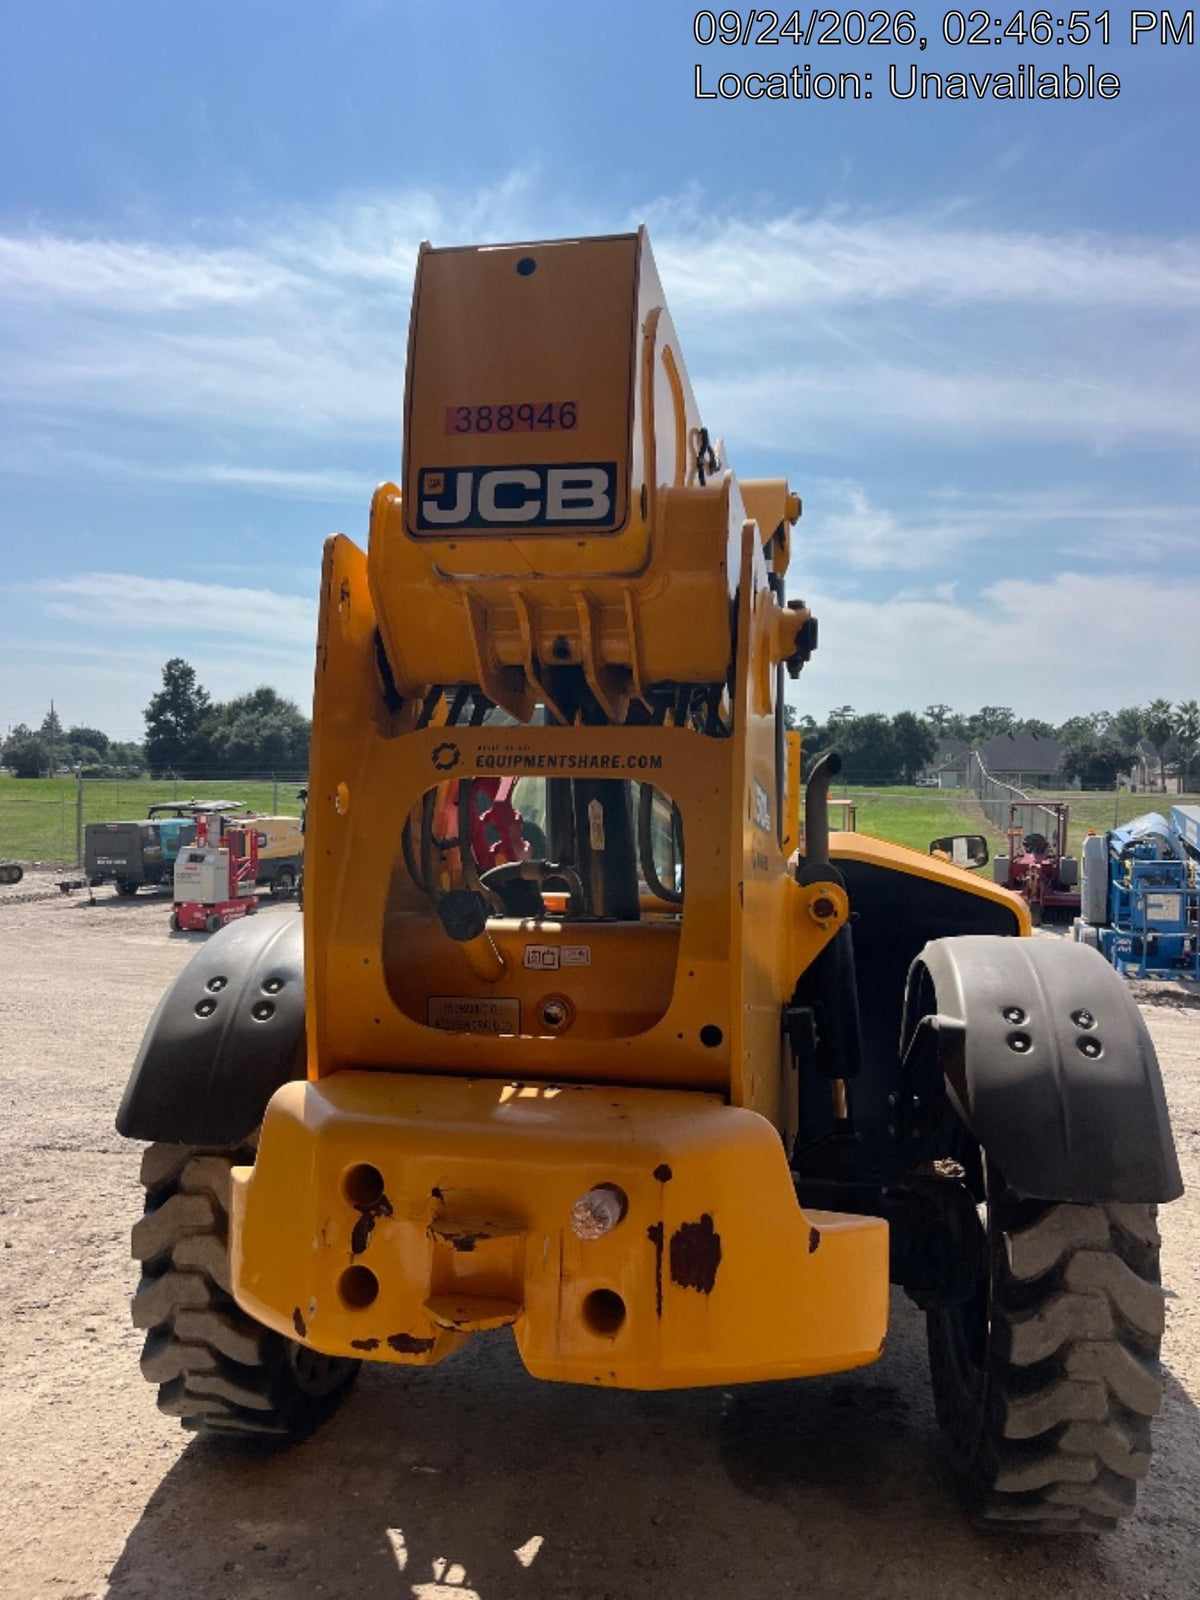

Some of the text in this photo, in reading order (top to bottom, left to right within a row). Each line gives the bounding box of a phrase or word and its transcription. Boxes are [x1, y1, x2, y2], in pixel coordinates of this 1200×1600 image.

[454, 401, 578, 433] 388946
[422, 467, 611, 524] JCB
[476, 754, 663, 769] EQUIPMENTSHARE.COM
